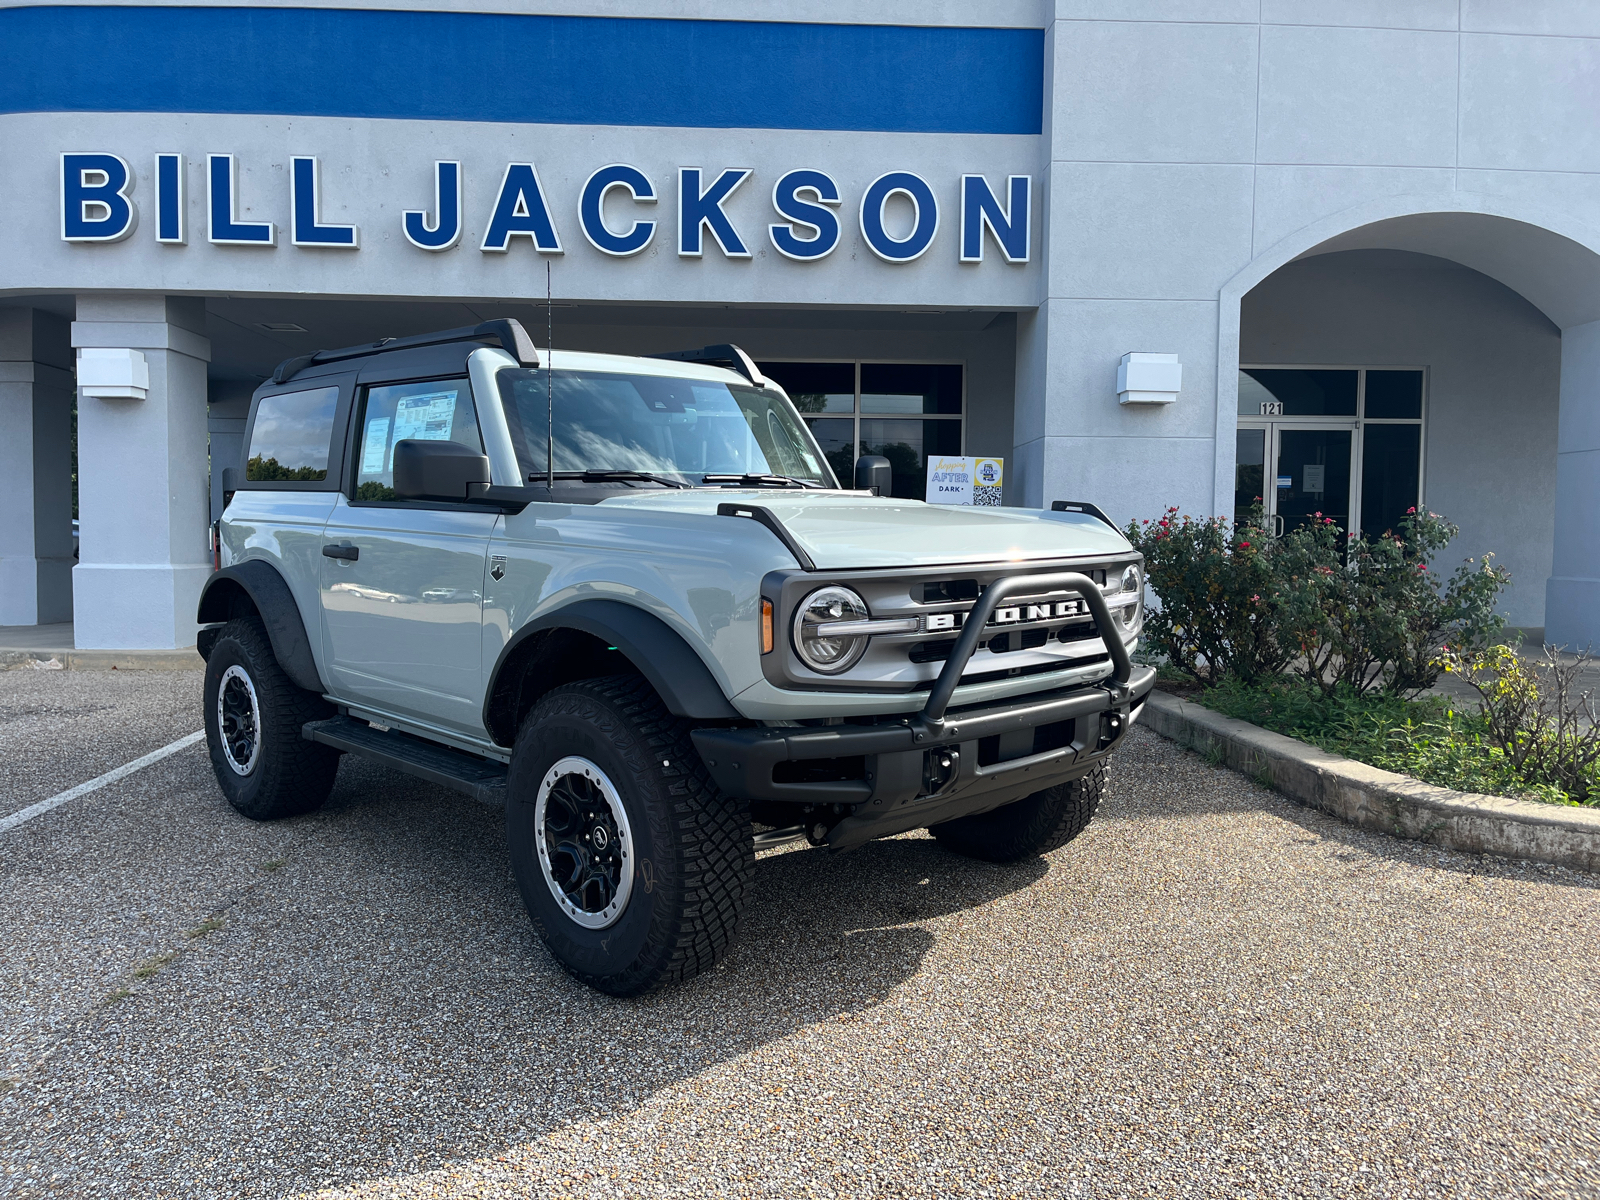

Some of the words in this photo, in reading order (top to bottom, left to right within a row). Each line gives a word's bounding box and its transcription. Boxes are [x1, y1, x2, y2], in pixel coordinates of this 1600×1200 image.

[60, 151, 360, 250] BILL
[401, 159, 1033, 266] JACKSON
[1262, 403, 1282, 415] 121
[935, 458, 967, 472] shopping
[932, 472, 969, 483] AFTER
[927, 601, 1091, 630] BONC
